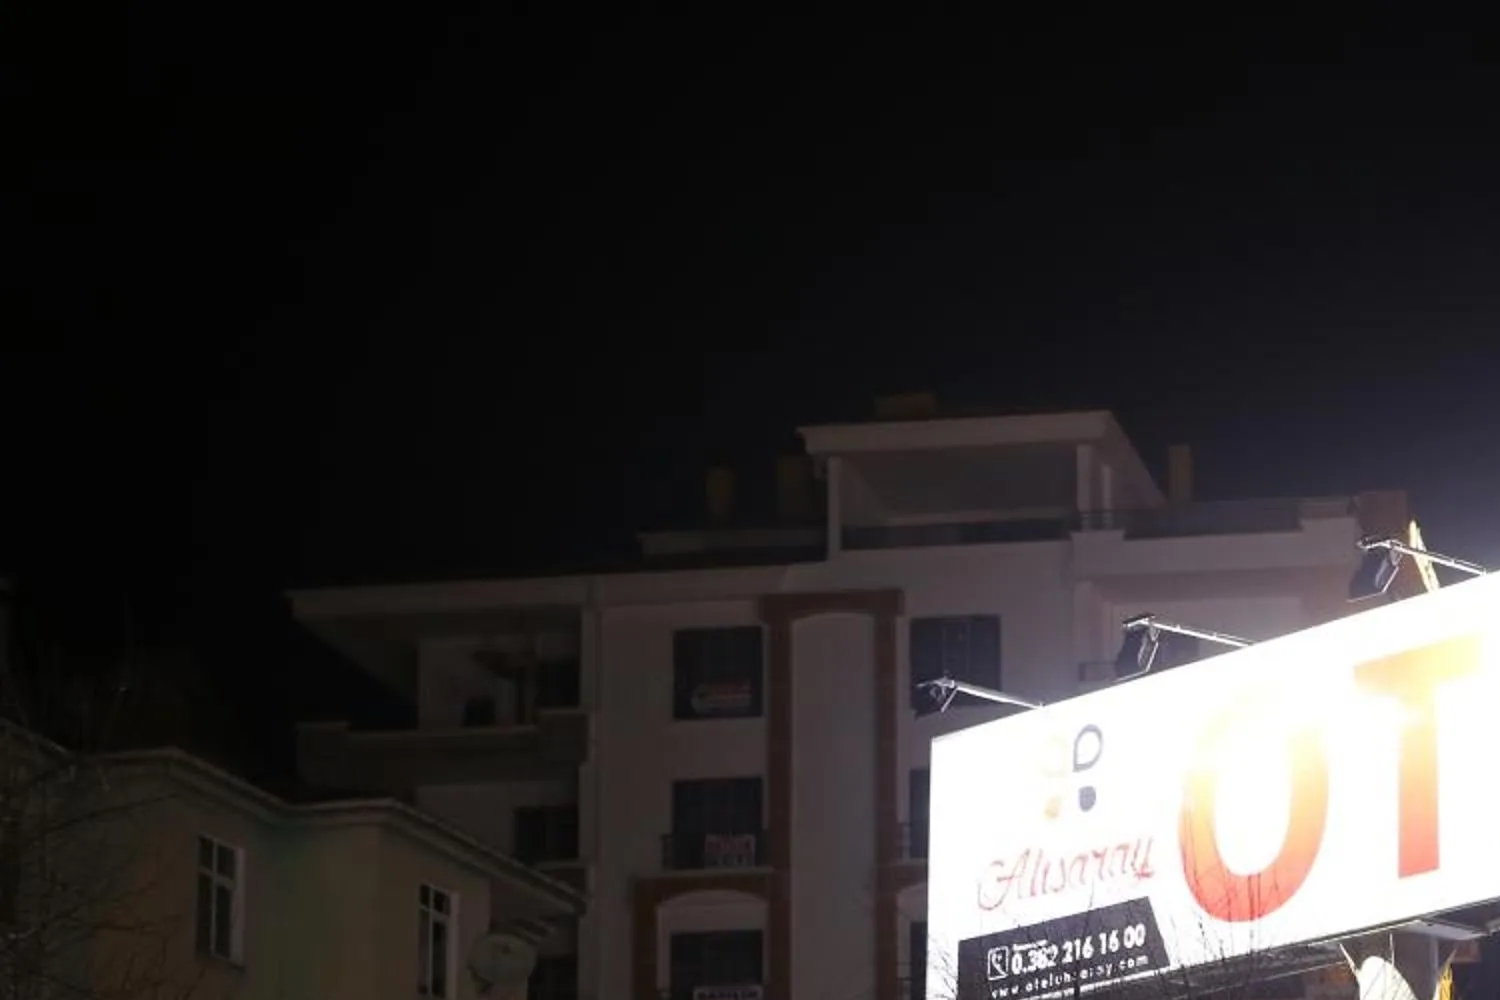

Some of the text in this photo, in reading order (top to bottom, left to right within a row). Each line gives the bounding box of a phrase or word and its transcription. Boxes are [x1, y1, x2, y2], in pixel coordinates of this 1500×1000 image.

[1061, 935, 1094, 964] 216
[1098, 929, 1120, 955] 16
[1123, 923, 1146, 949] 00
